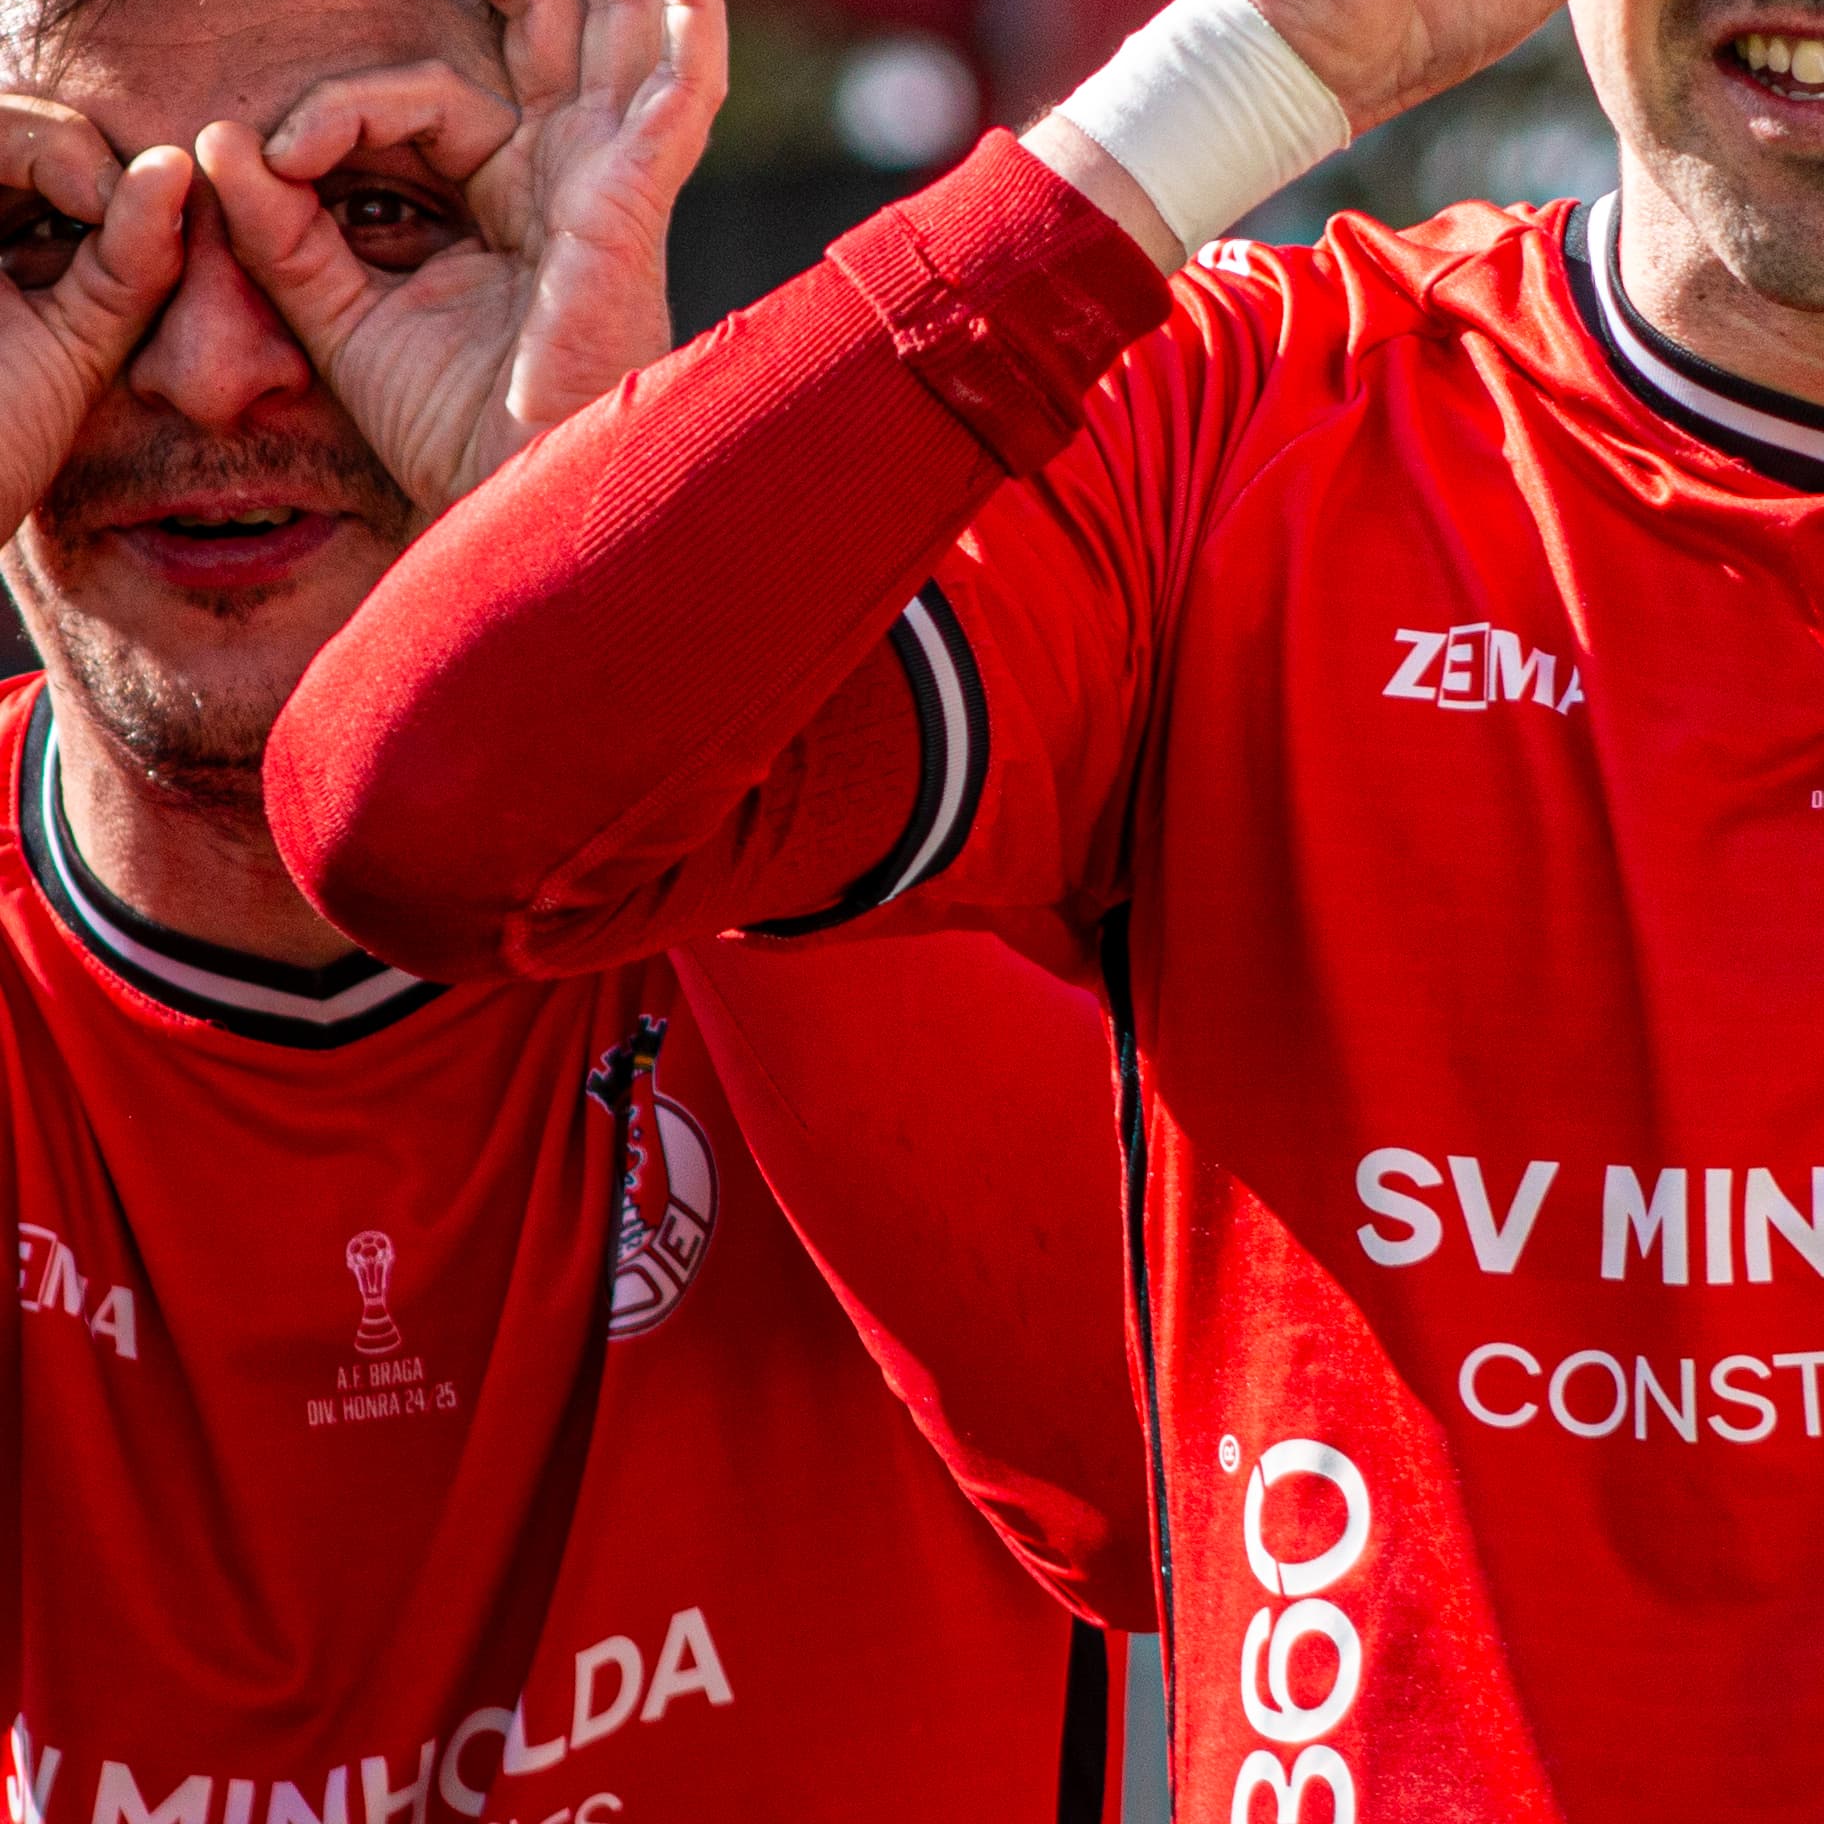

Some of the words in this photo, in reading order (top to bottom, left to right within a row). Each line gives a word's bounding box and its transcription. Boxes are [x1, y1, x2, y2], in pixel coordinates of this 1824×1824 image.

[1355, 1146, 1559, 1275] SV
[342, 1391, 400, 1421] HONRA
[369, 1355, 424, 1387] BRAGA
[503, 1606, 735, 1776] LDA
